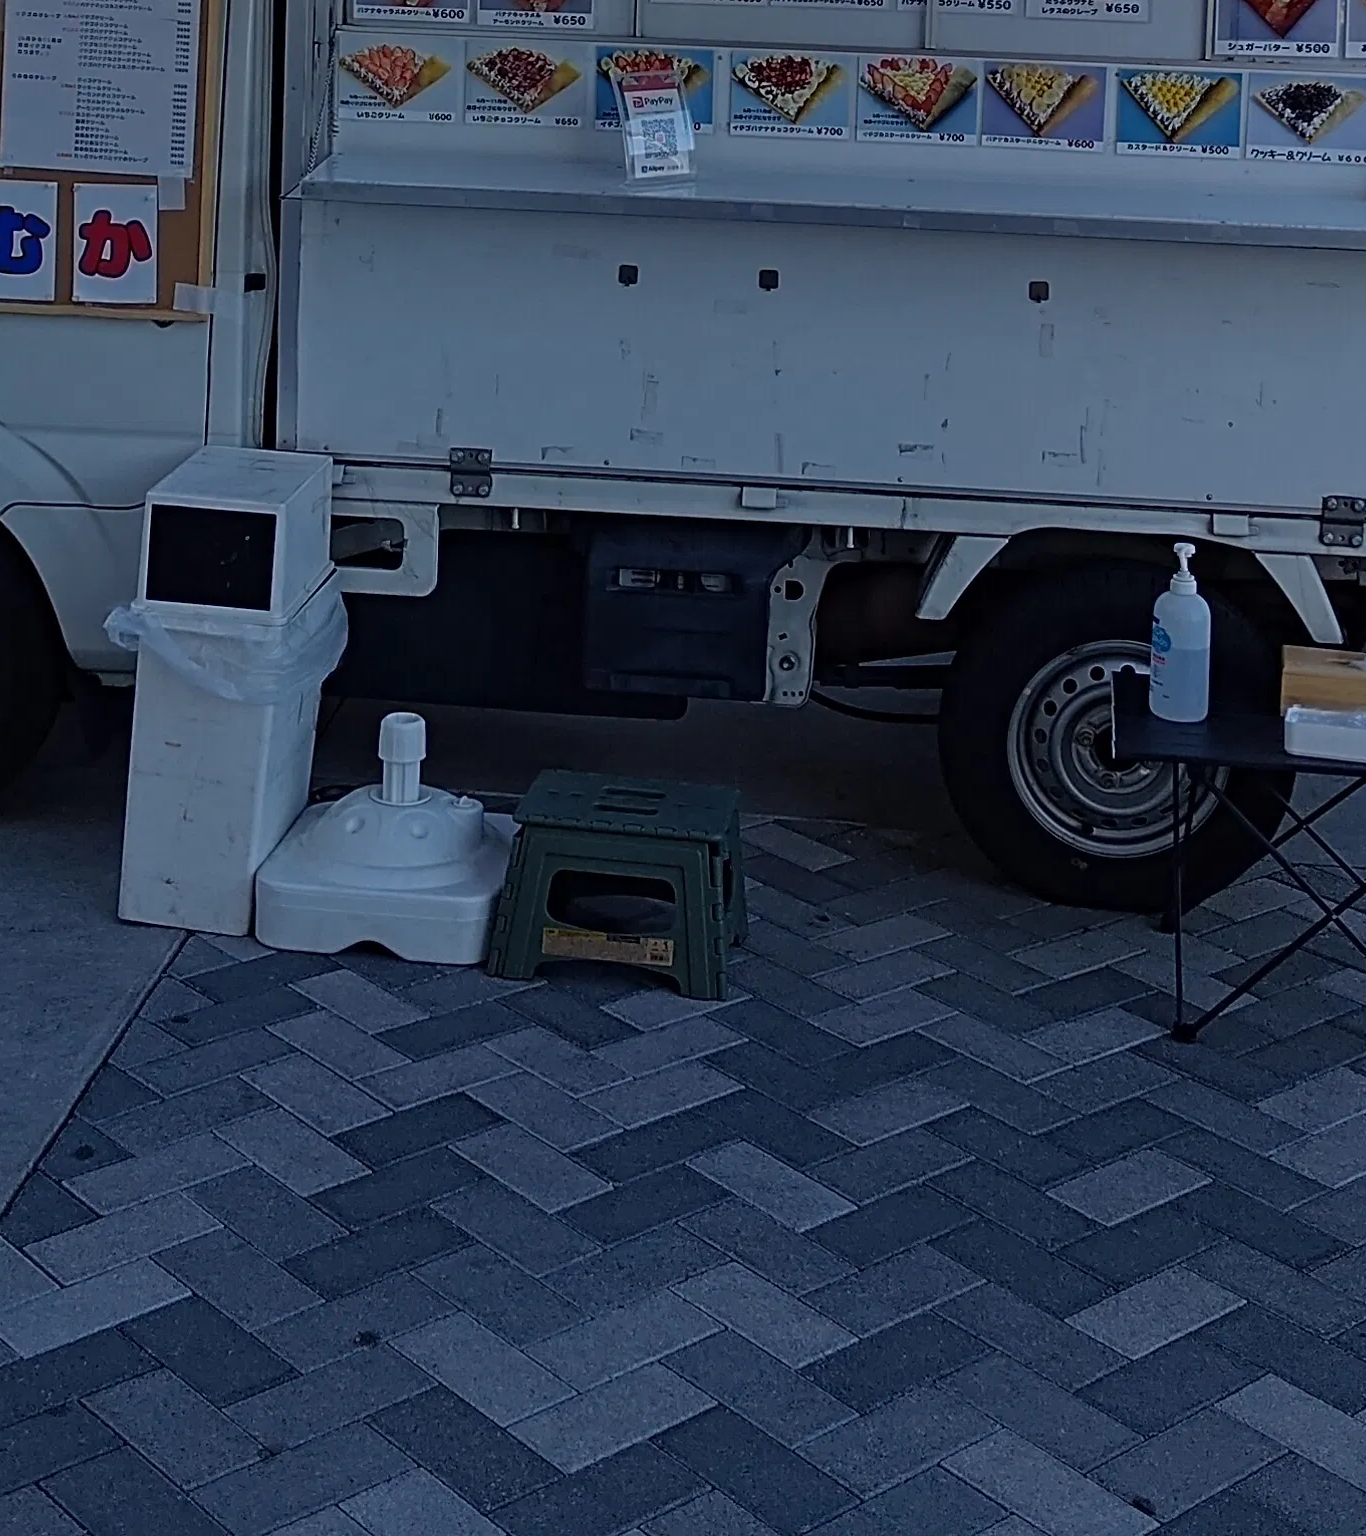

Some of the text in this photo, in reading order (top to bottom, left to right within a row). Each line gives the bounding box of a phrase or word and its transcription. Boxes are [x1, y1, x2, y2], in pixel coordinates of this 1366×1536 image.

[978, 0, 1012, 11] ¥550
[1105, 3, 1139, 14] ¥650
[432, 8, 465, 20] ¥600
[553, 15, 586, 26] ¥650
[1227, 42, 1330, 54] シュガーバター ¥500
[644, 97, 673, 108] PayPay
[429, 113, 452, 121] ¥600
[555, 117, 578, 126] ¥650
[816, 126, 843, 136] ¥700
[938, 133, 965, 143] ¥700
[1067, 139, 1095, 149] ¥600
[1201, 145, 1229, 155] ¥500
[1251, 148, 1331, 162] クッキー&クリーム
